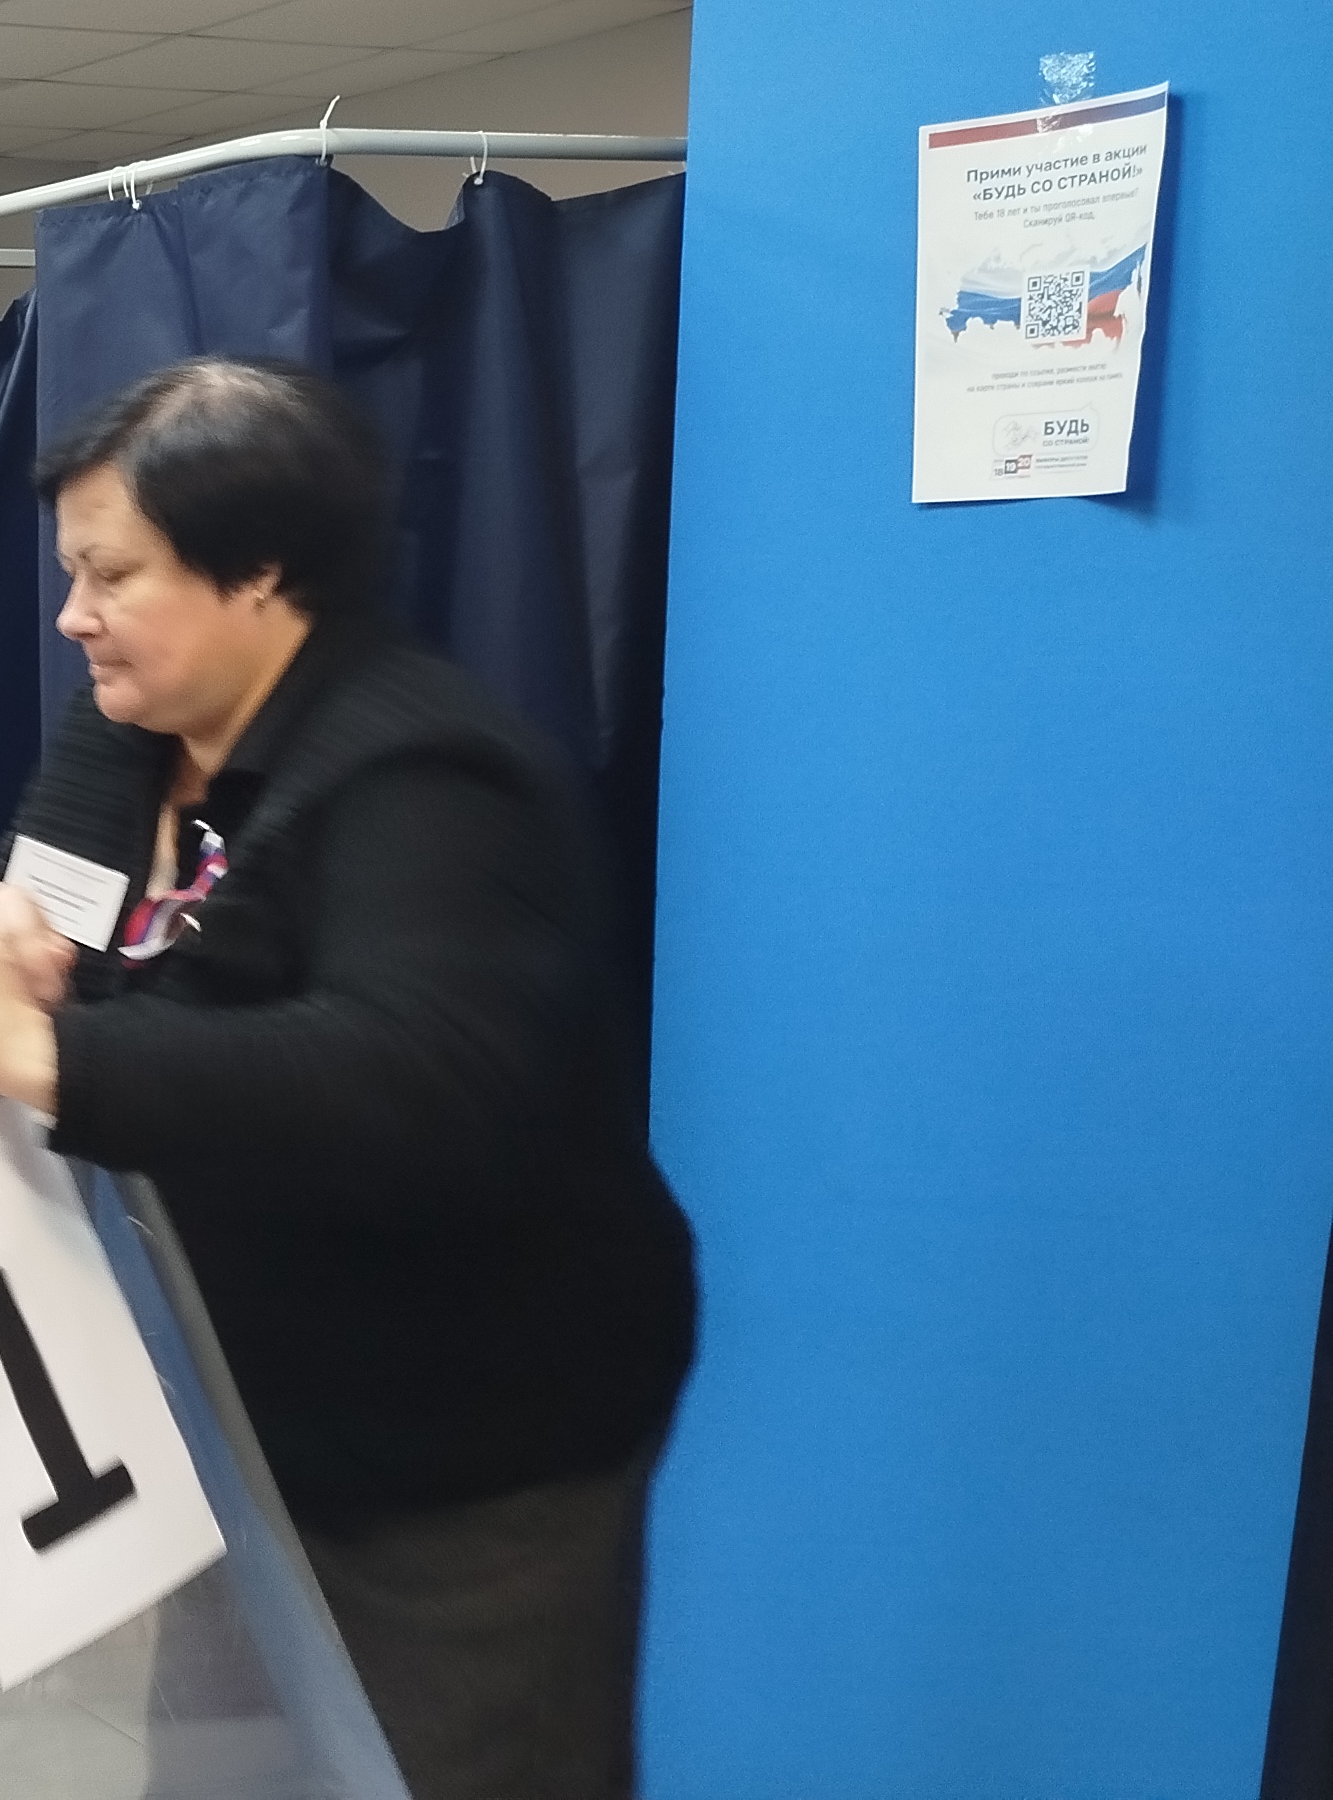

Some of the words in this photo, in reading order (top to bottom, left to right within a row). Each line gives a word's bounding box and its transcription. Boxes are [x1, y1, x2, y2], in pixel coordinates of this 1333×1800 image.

[966, 166, 1021, 184] Прими
[1026, 154, 1089, 177] участие
[1092, 153, 1100, 163] в
[1104, 144, 1147, 161] акции
[972, 183, 1026, 201] «БУДЬ
[1031, 179, 1053, 194] СО
[1057, 162, 1143, 190] СТРАНОЙ!»
[974, 210, 994, 221] Тебе
[996, 208, 1005, 218] 18
[1043, 418, 1090, 437] БУДЬ
